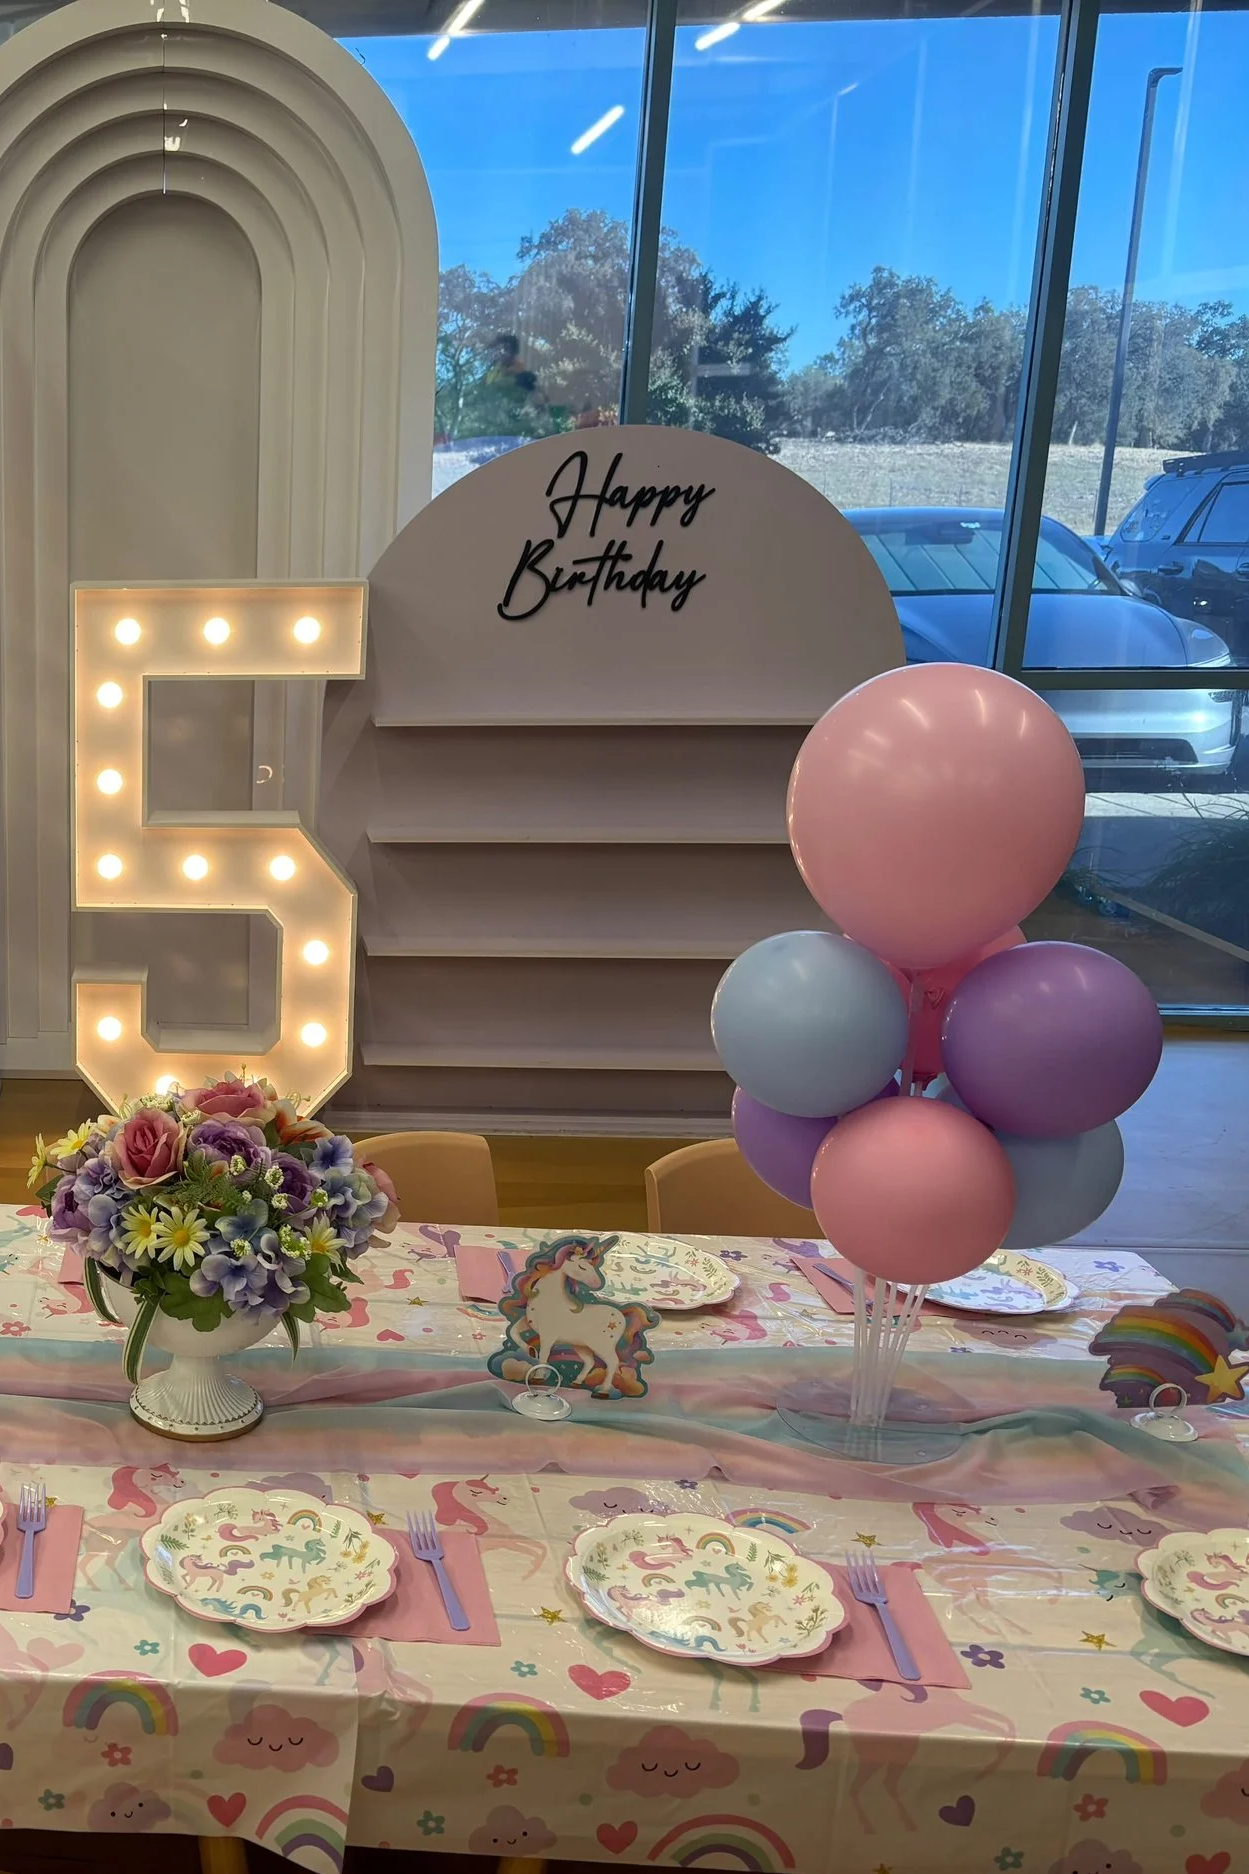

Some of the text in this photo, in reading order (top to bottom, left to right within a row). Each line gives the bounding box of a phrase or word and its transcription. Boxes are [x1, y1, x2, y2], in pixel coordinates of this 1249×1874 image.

[546, 451, 716, 538] Happy
[497, 539, 707, 620] Birthday
[70, 579, 369, 1119] 5
